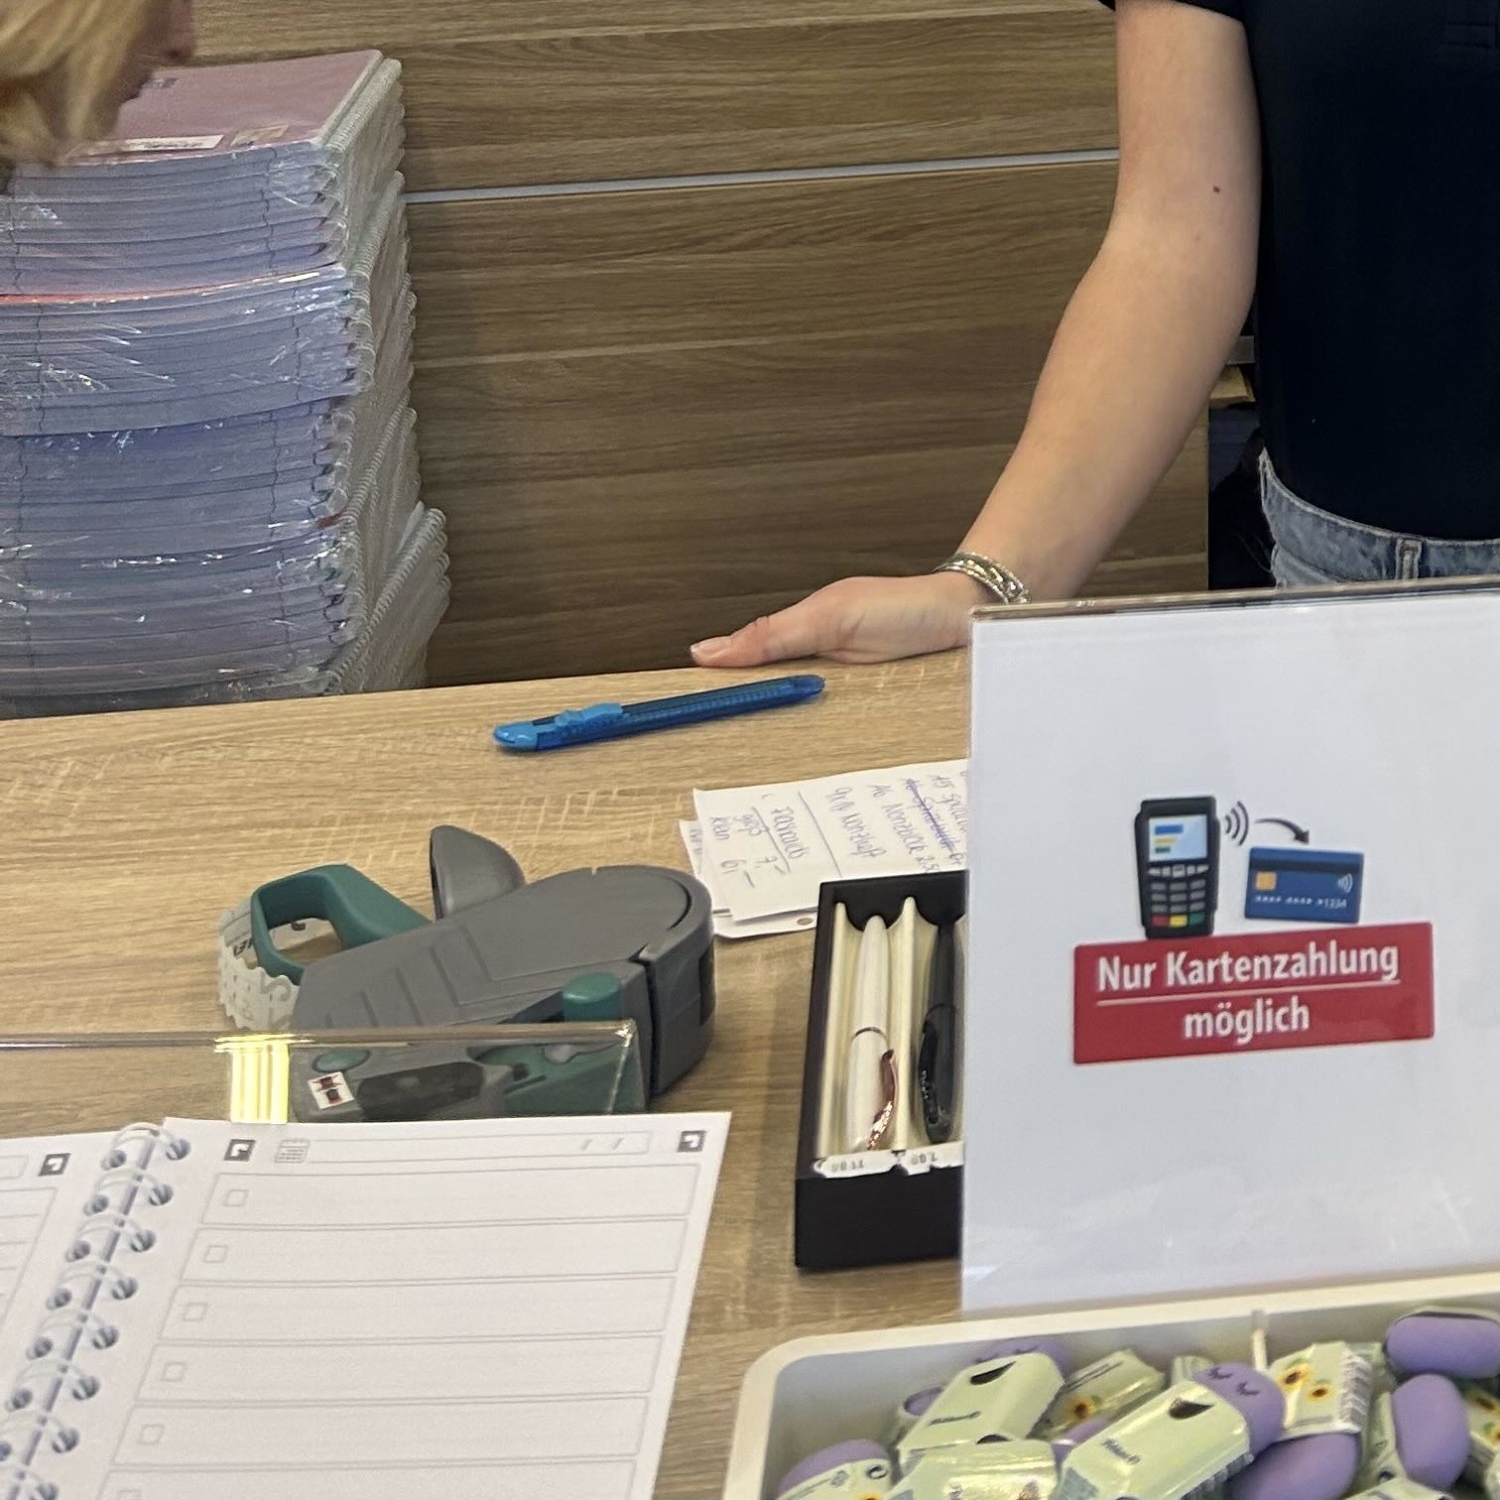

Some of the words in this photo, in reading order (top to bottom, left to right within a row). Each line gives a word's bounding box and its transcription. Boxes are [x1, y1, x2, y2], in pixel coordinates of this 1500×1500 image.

[1098, 955, 1156, 991] Nur
[1166, 939, 1400, 989] Kartenzahlung
[1184, 996, 1310, 1045] möglich
